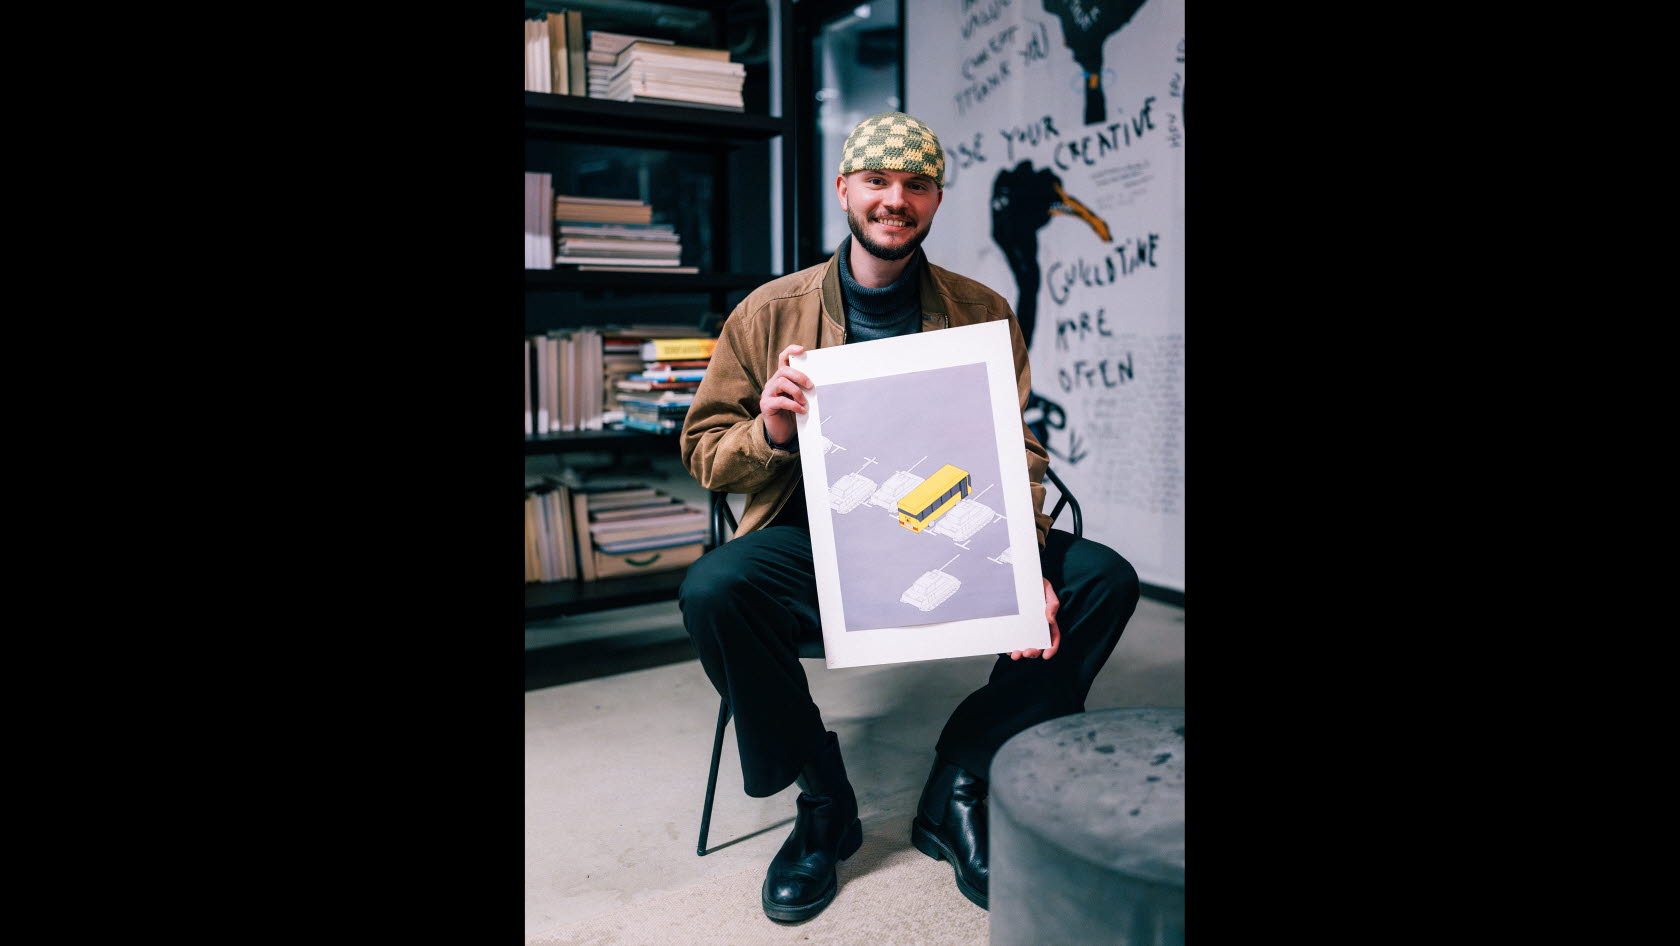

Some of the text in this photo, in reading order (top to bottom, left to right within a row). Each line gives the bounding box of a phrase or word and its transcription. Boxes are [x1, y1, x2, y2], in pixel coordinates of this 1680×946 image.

[1000, 114, 1060, 161] YOUR
[1054, 96, 1157, 172] CREATIVE
[1055, 307, 1113, 352] MORE
[1058, 351, 1134, 394] OFTEN
